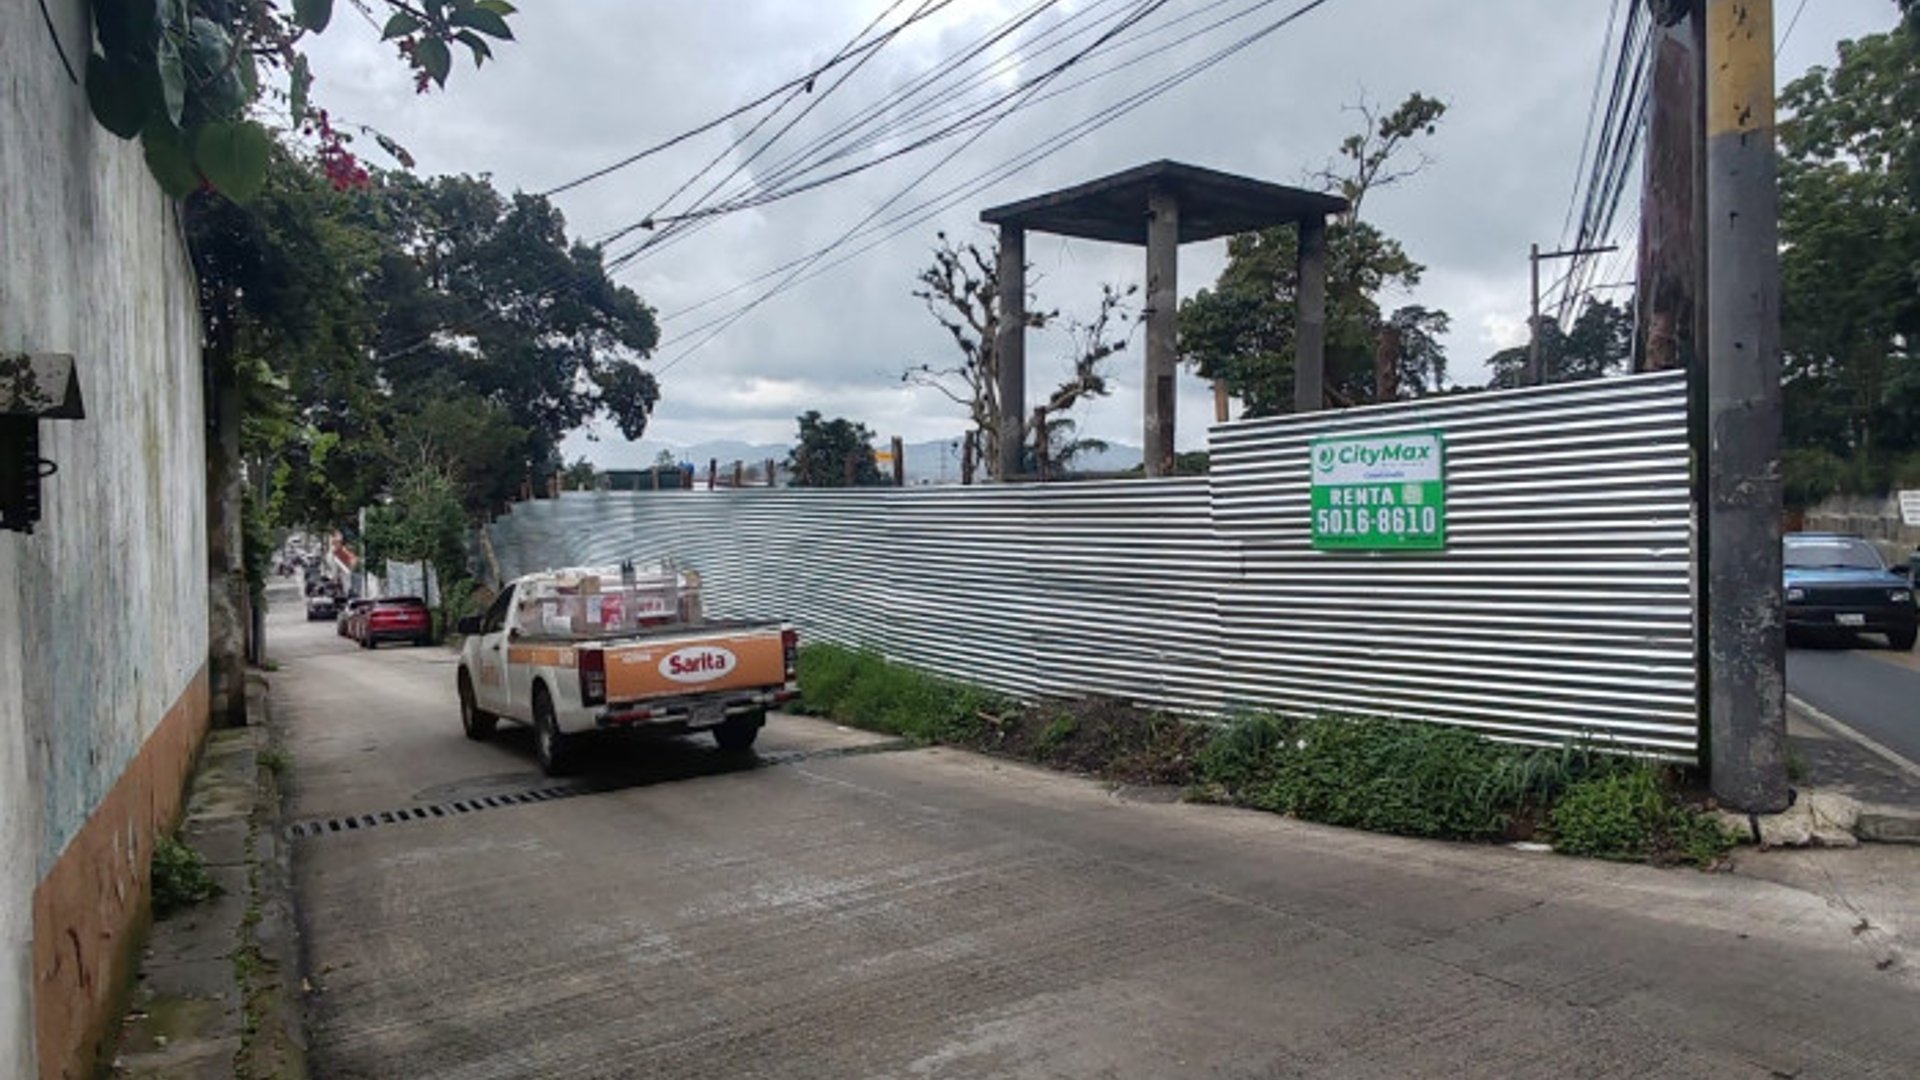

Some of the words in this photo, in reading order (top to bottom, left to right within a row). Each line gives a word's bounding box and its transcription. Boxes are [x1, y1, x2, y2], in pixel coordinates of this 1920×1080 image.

[1338, 443, 1431, 466] CityMax
[1330, 487, 1395, 505] RENTA
[1317, 506, 1436, 534] 5016-8610
[669, 651, 726, 675] Sarita
